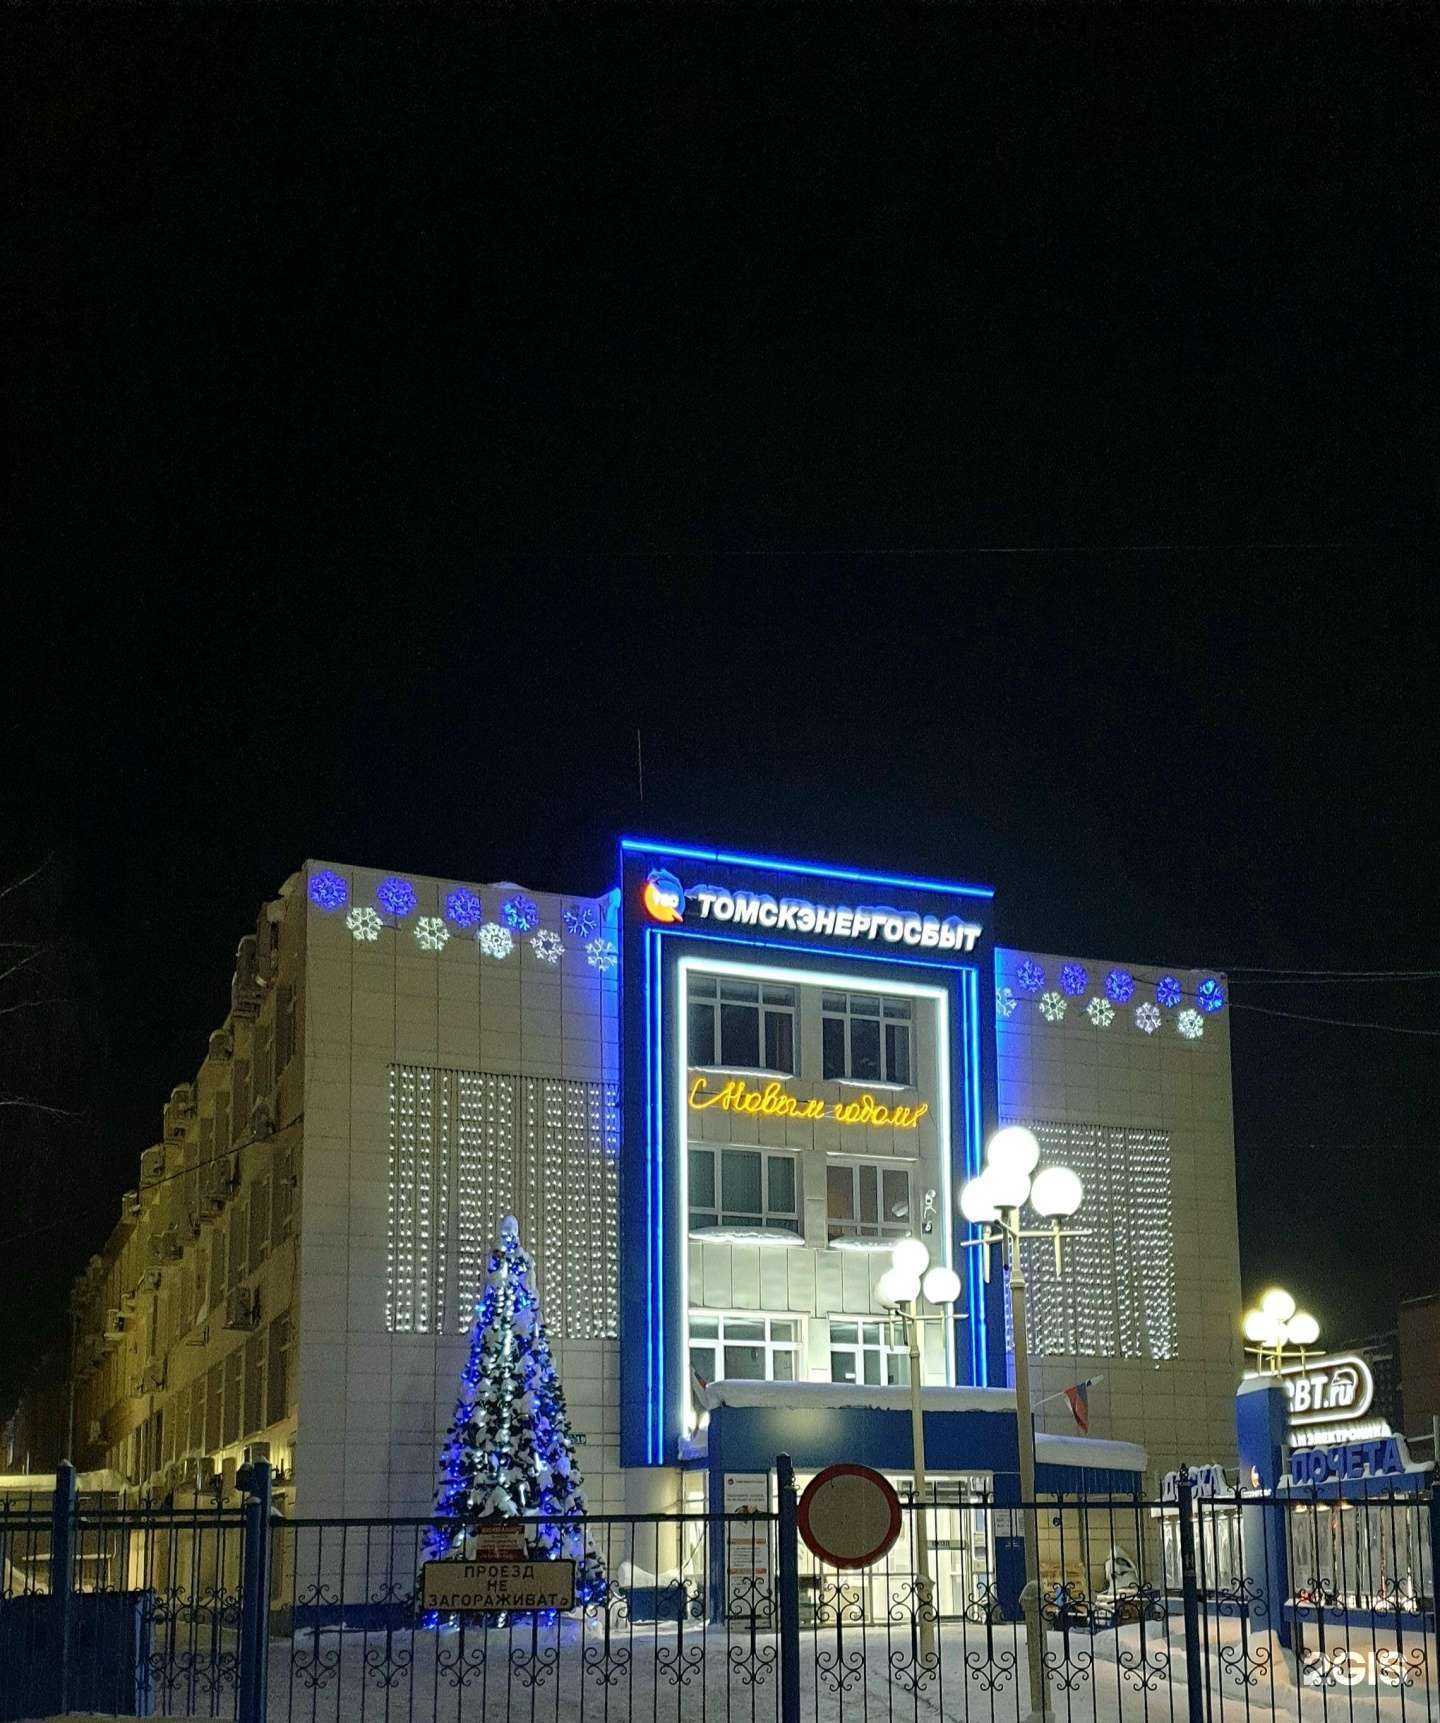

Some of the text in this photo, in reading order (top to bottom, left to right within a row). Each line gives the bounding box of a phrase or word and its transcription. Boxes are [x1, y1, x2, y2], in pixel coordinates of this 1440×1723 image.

[698, 894, 983, 951] ТОМСКЭНЕРГОСБЫТ
[688, 1077, 722, 1109] С
[722, 1080, 825, 1119] Новым
[1291, 1437, 1406, 1485] ПОЧЕТА
[464, 1565, 534, 1579] ПРОЕЗД
[487, 1580, 507, 1592] НЕ
